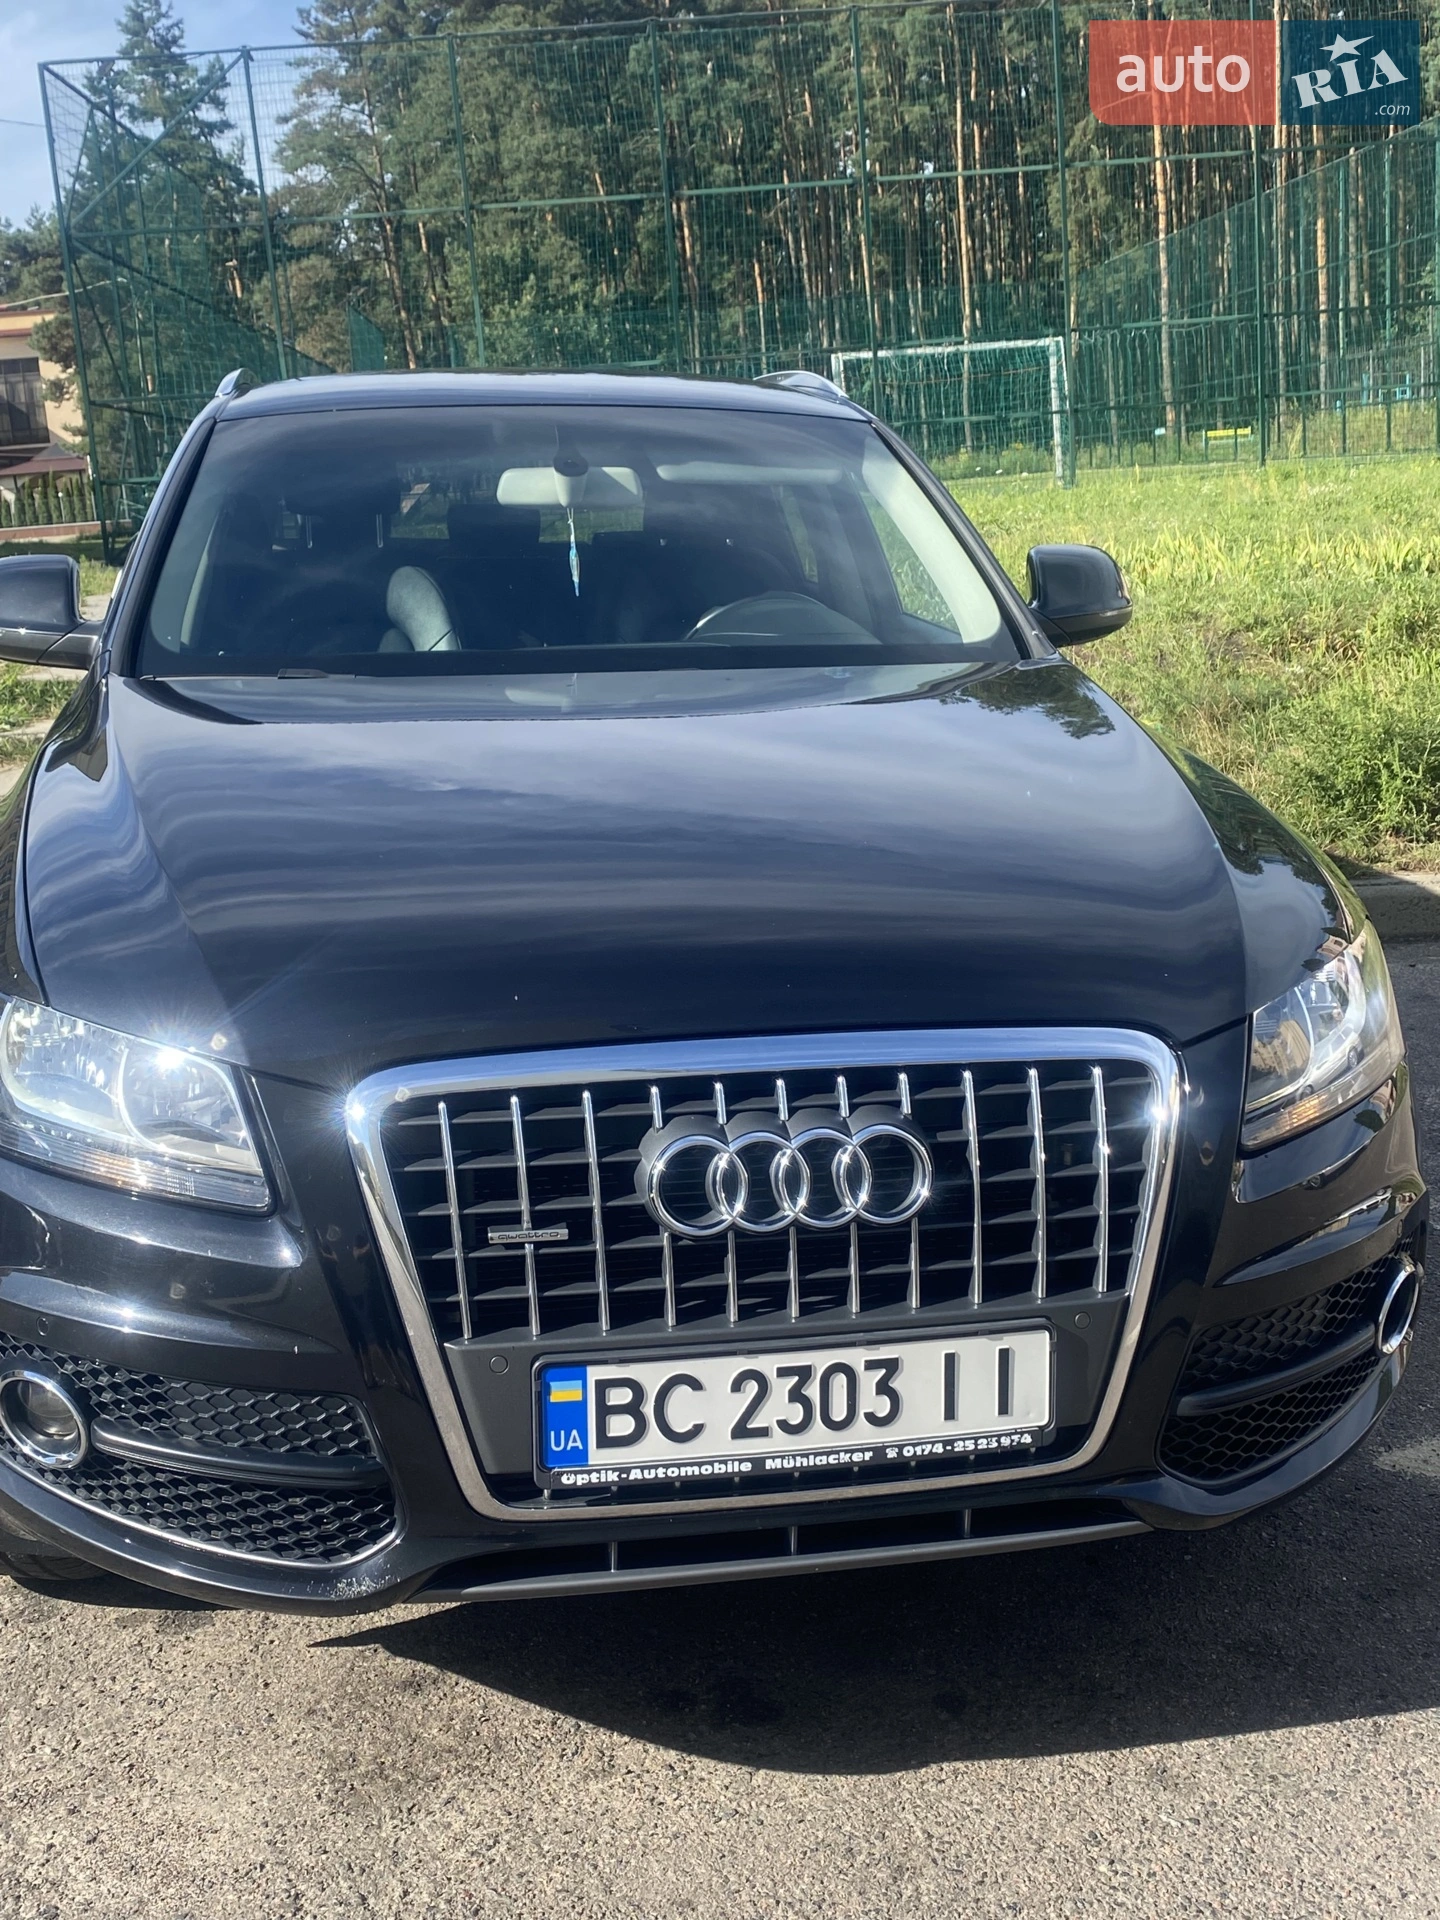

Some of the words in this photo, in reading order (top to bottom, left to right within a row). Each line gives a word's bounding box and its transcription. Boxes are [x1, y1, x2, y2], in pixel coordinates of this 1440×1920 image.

[497, 1231, 560, 1242] quattro
[594, 1372, 706, 1450] BC
[729, 1356, 901, 1440] 2303
[550, 1429, 583, 1451] UA
[765, 1450, 873, 1469] Mühlacker
